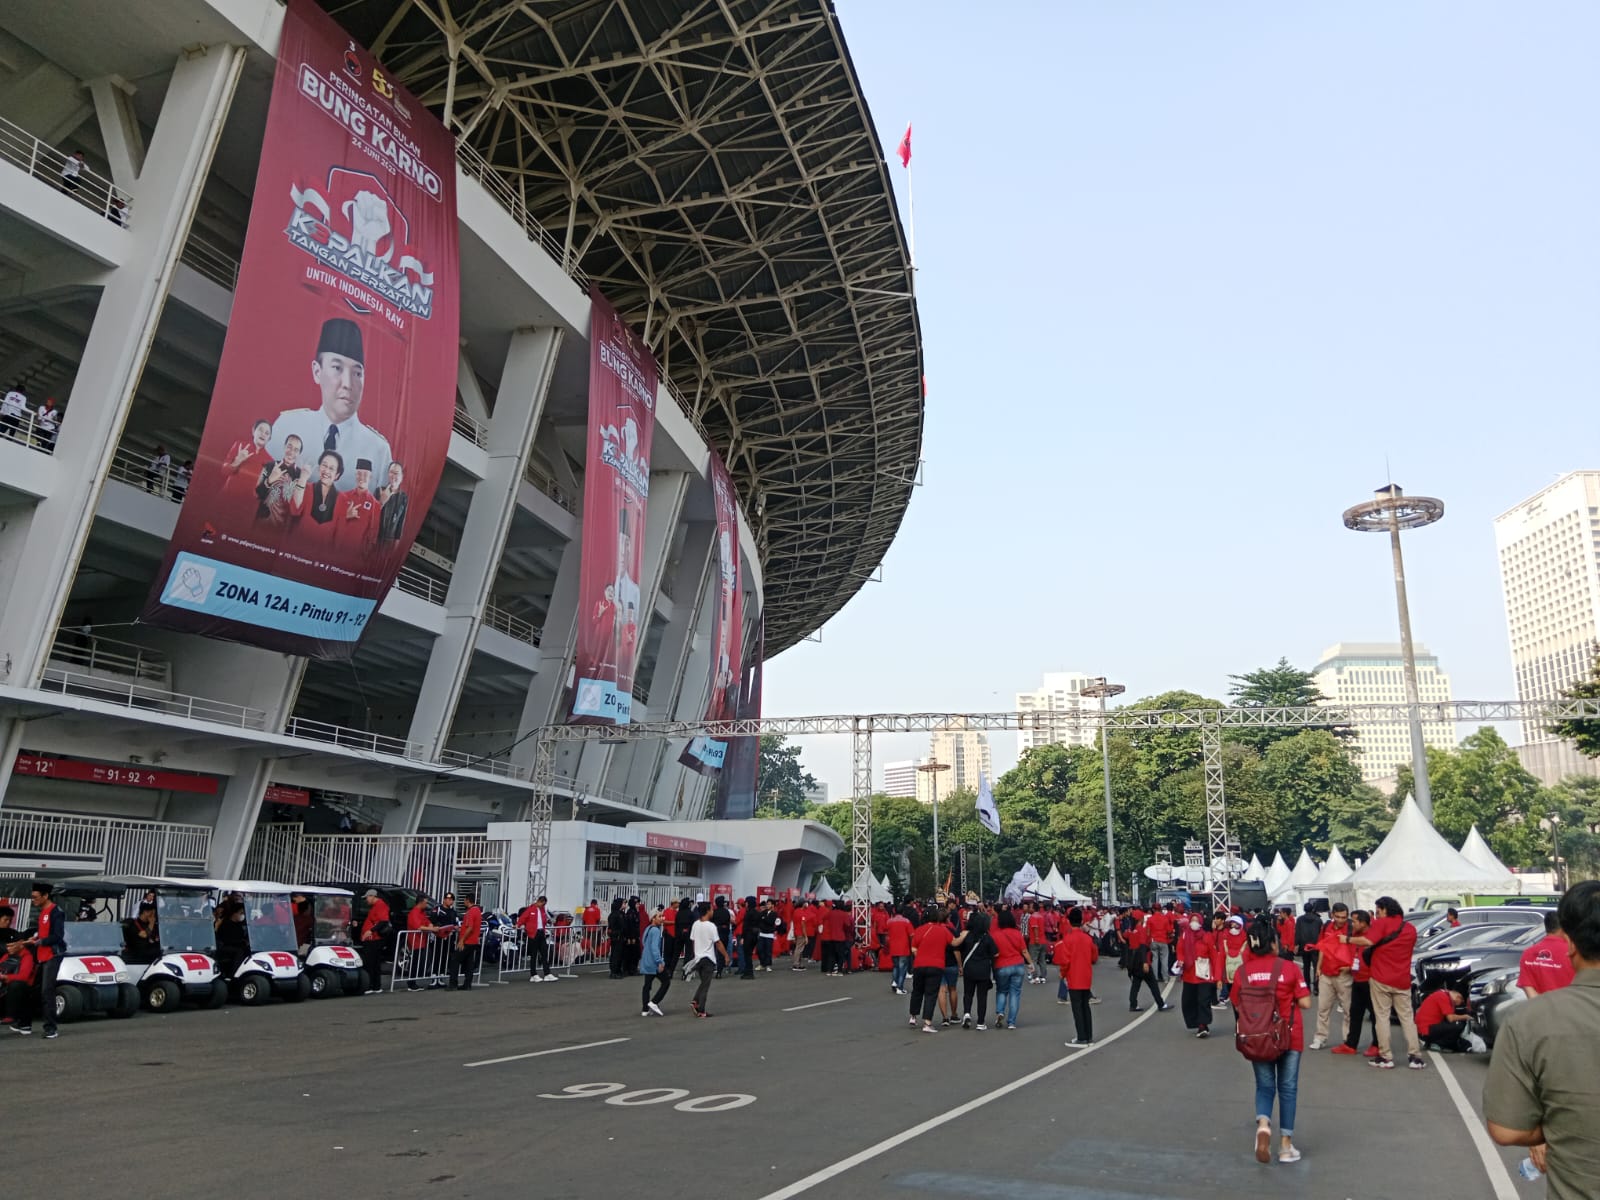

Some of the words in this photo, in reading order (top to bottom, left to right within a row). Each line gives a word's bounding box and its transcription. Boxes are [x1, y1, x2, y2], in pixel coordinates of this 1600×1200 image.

[302, 70, 366, 136] BUNG
[371, 126, 439, 195] KARNO
[330, 71, 392, 130] PERINGATAN
[393, 125, 421, 158] BULAN
[363, 144, 380, 162] JUNI
[291, 230, 349, 272] TANGAN
[350, 268, 429, 316] PERSATUAN
[306, 266, 337, 288] UNTUK
[338, 279, 384, 314] INDONESIA
[215, 580, 258, 605] ZONA
[264, 593, 290, 613] 12A
[299, 602, 332, 623] Pintu
[334, 610, 348, 625] 91
[107, 769, 119, 781] 91
[127, 771, 140, 783] 92
[536, 1082, 757, 1112] 900
